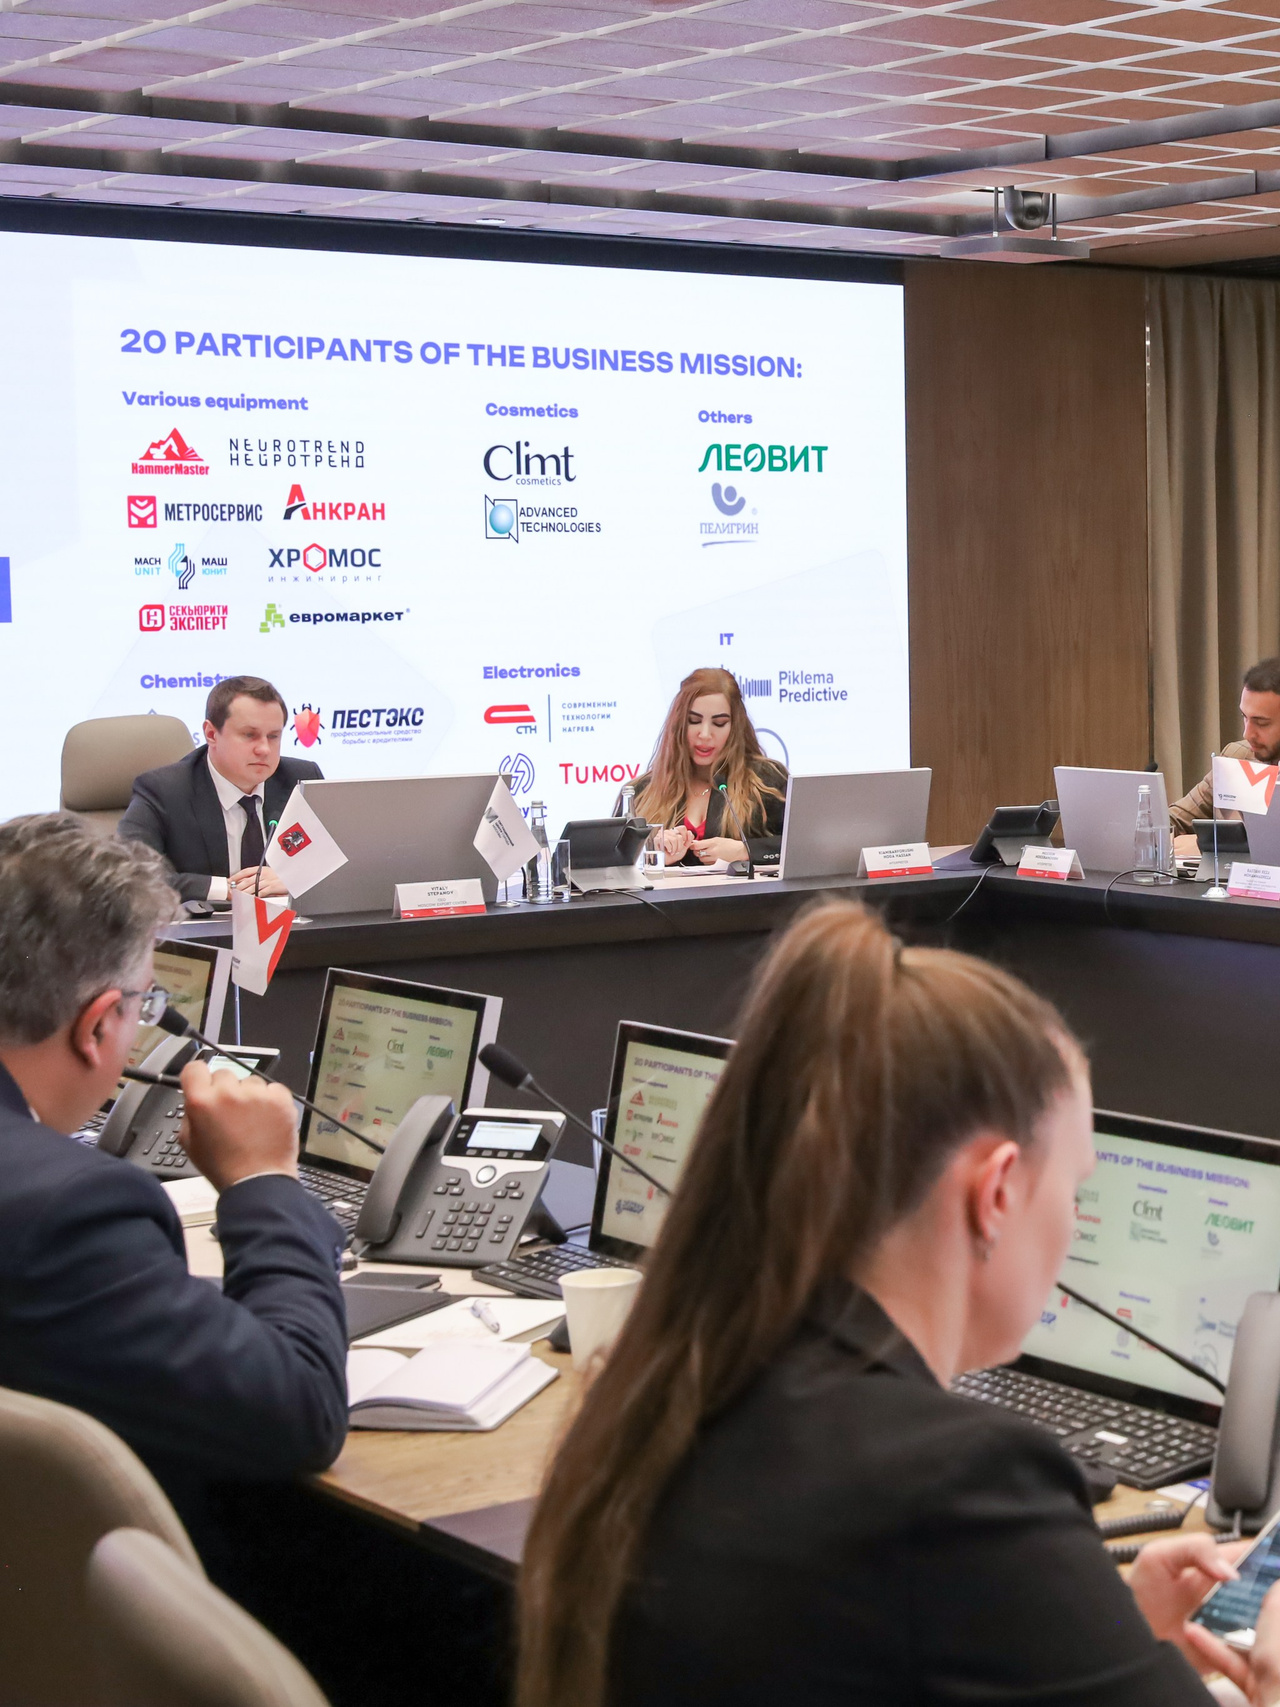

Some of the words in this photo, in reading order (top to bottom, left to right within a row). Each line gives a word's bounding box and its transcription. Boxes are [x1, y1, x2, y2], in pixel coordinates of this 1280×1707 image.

[120, 329, 167, 354] 20
[175, 331, 414, 364] PARTICIPANTS
[420, 342, 461, 365] OF
[467, 343, 526, 368] THE
[532, 346, 674, 373] BUSINESS
[680, 353, 803, 379] MISSION:
[122, 391, 201, 408] Various
[205, 394, 309, 412] equipment
[485, 402, 579, 419] Cosmetics
[698, 410, 753, 425] Others
[229, 438, 365, 454] NEUROTREND
[698, 443, 829, 473] ЛЕОВИТ
[131, 462, 210, 476] HammerMaster
[515, 477, 562, 486] cosmetics
[164, 503, 263, 522] МЕТРОСЕРВИС
[519, 506, 578, 519] ADVANCED
[520, 521, 602, 534] TECHNOLOGIES
[699, 522, 759, 535] ПЕЛИГРИН
[202, 557, 228, 566] МАШ
[268, 542, 382, 573] ХРОМОС
[134, 567, 161, 576] UNIT
[202, 568, 228, 576] ЮНИТ
[169, 604, 229, 617] СЕКЬЮРИТИ
[289, 610, 404, 626] евромаркет
[170, 615, 228, 631] ЭКСПЕРТ
[719, 633, 734, 646] IT
[482, 663, 581, 680] Electronics
[779, 670, 834, 686] Piklema
[140, 672, 234, 689] Chemist
[779, 686, 848, 703] Predictive
[562, 701, 618, 709] СОВРЕМЕННЫЕ
[332, 707, 425, 730] ПЕСТЭКС
[562, 713, 612, 721] ТЕХНОЛОГИИ
[1121, 1155, 1133, 1166] OF
[1136, 1157, 1154, 1171] THE
[1156, 1161, 1203, 1181] BUSINESS
[1205, 1213, 1255, 1234] ЛЕОВИТ
